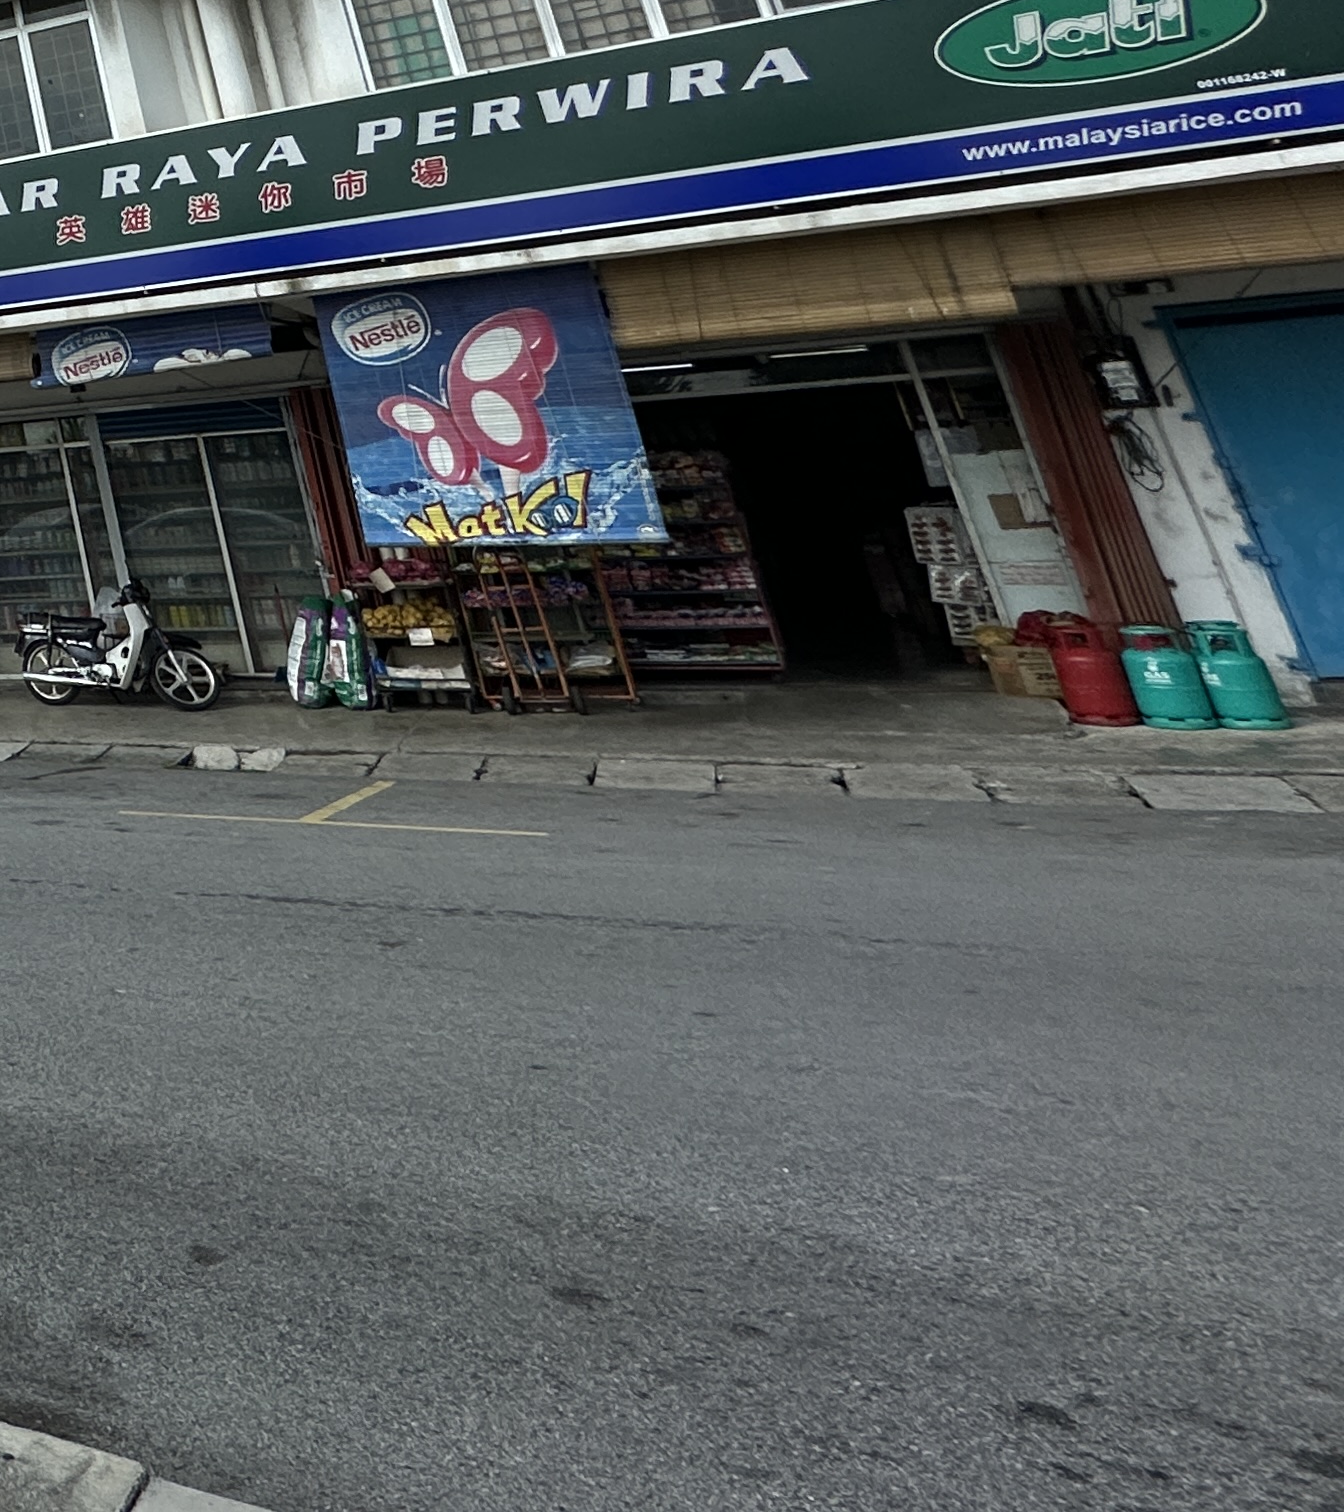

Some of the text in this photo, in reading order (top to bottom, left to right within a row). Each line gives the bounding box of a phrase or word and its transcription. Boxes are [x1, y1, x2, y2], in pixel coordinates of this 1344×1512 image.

[101, 134, 309, 200] RAYA
[356, 46, 810, 156] PERWIRA
[962, 98, 1303, 162] www.malaysiarice.com
[56, 155, 448, 246] 英雄迷你市場
[343, 297, 403, 323] ICE CREAM
[1143, 670, 1171, 679] GAS
